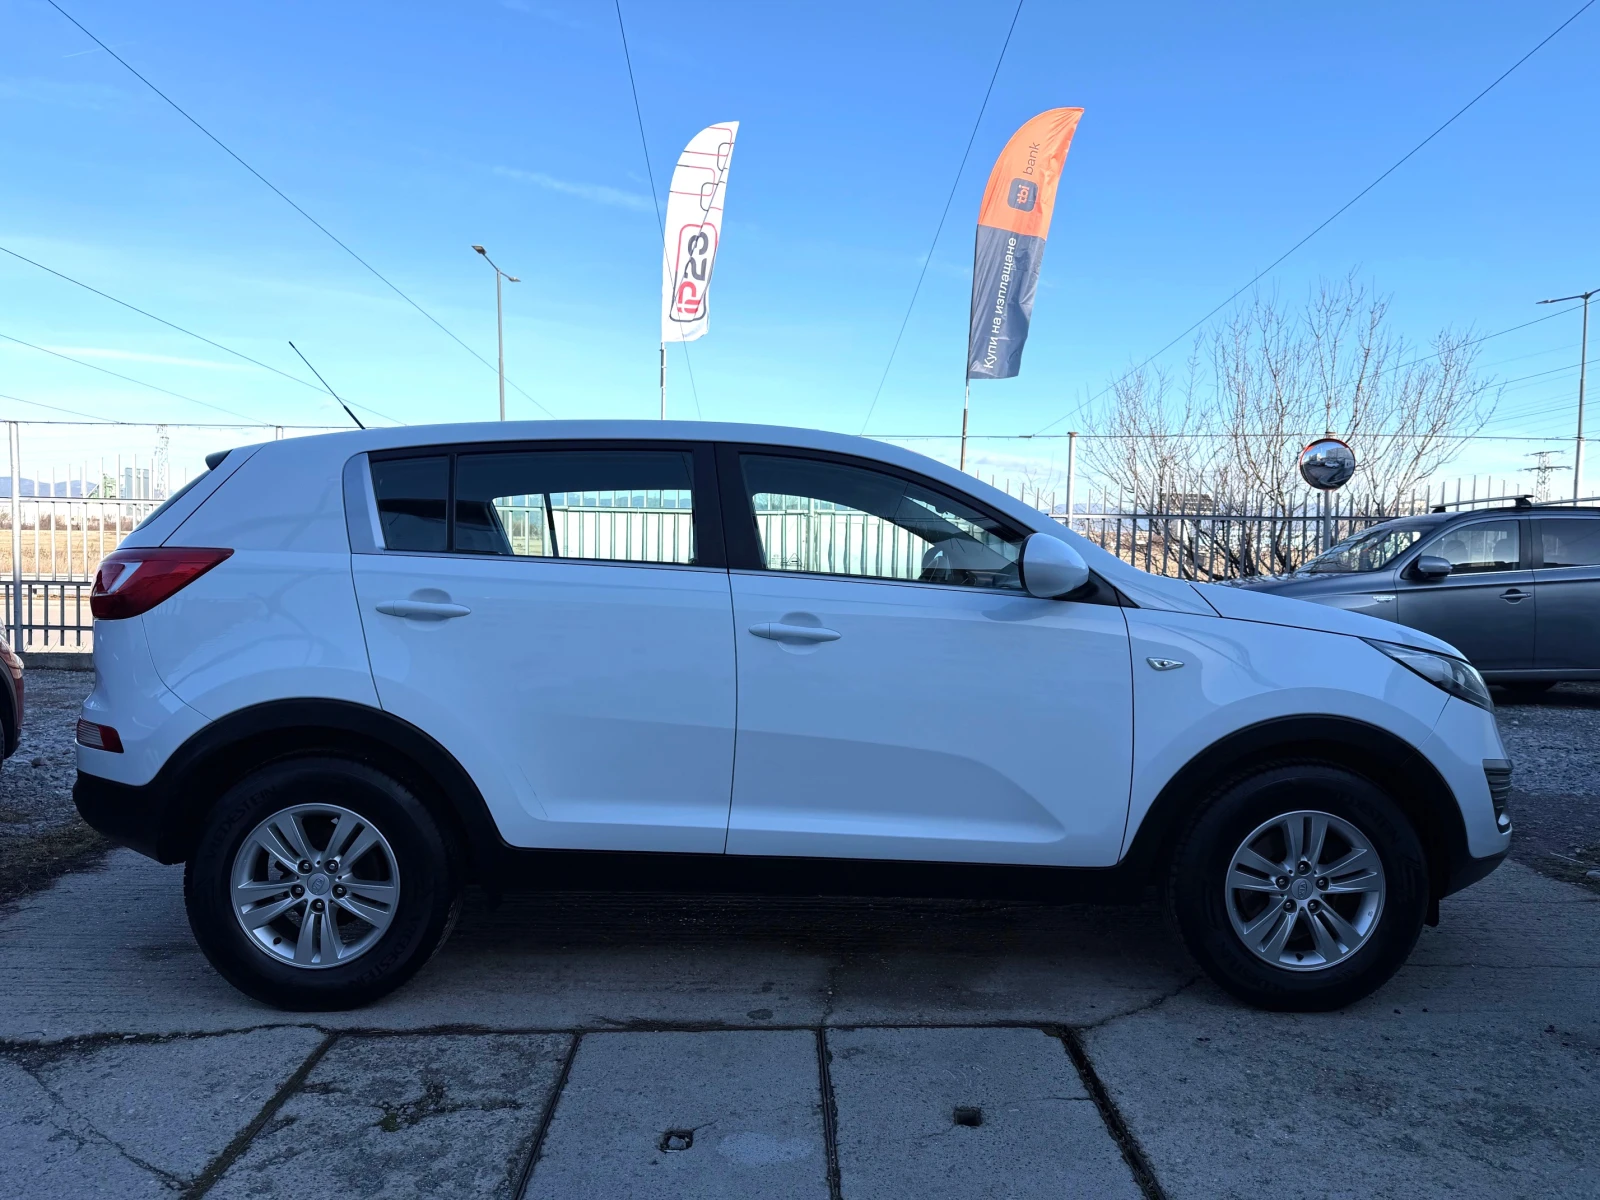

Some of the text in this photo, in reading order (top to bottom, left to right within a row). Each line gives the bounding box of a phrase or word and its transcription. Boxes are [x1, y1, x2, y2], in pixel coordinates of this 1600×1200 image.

[1016, 142, 1041, 205] tbi bank
[983, 236, 1017, 369] Купи на изплащане
